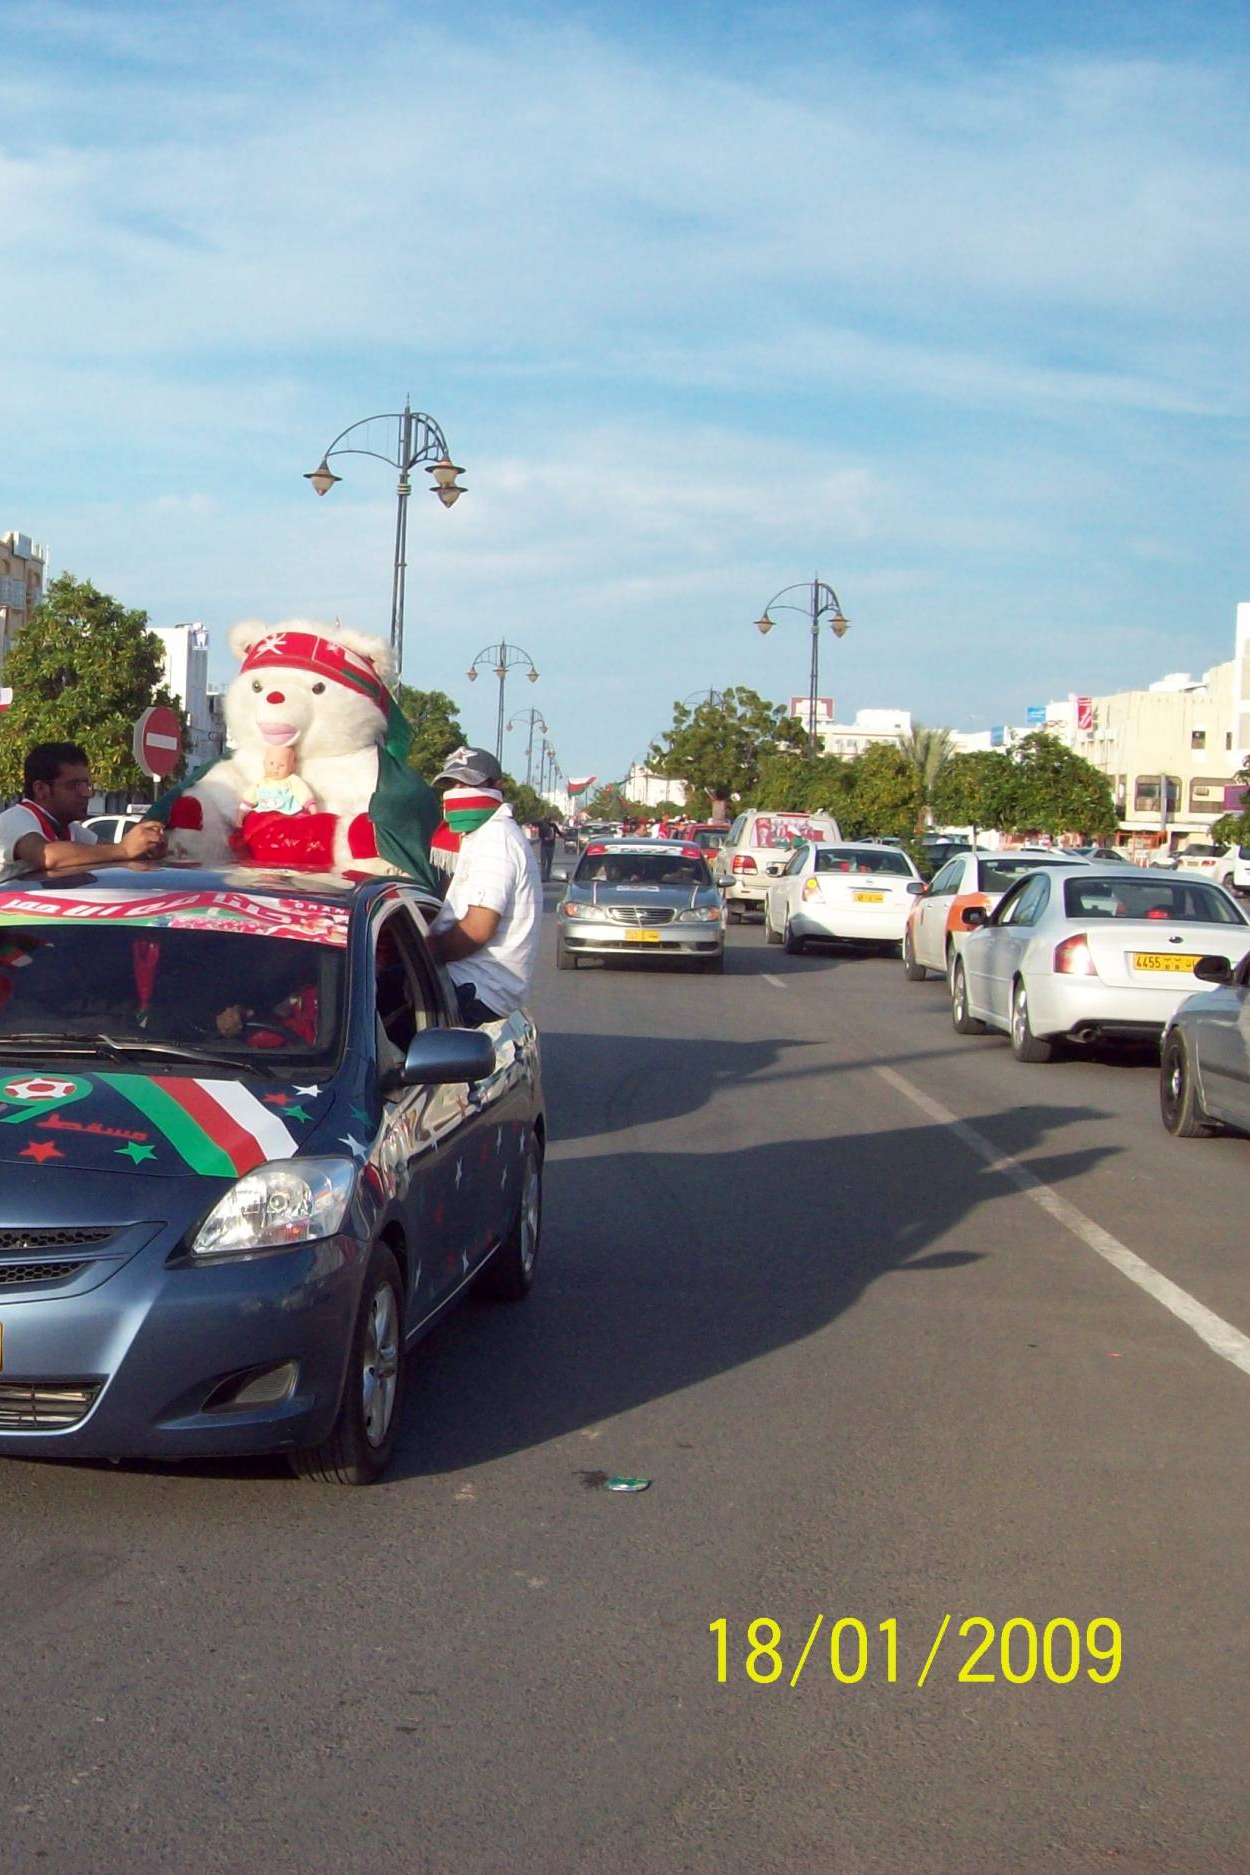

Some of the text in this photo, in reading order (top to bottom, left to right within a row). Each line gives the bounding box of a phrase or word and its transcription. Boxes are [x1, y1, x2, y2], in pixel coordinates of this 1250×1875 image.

[295, 902, 345, 915] OMAN
[1136, 955, 1161, 969] 4455
[36, 1113, 149, 1141] مسقط
